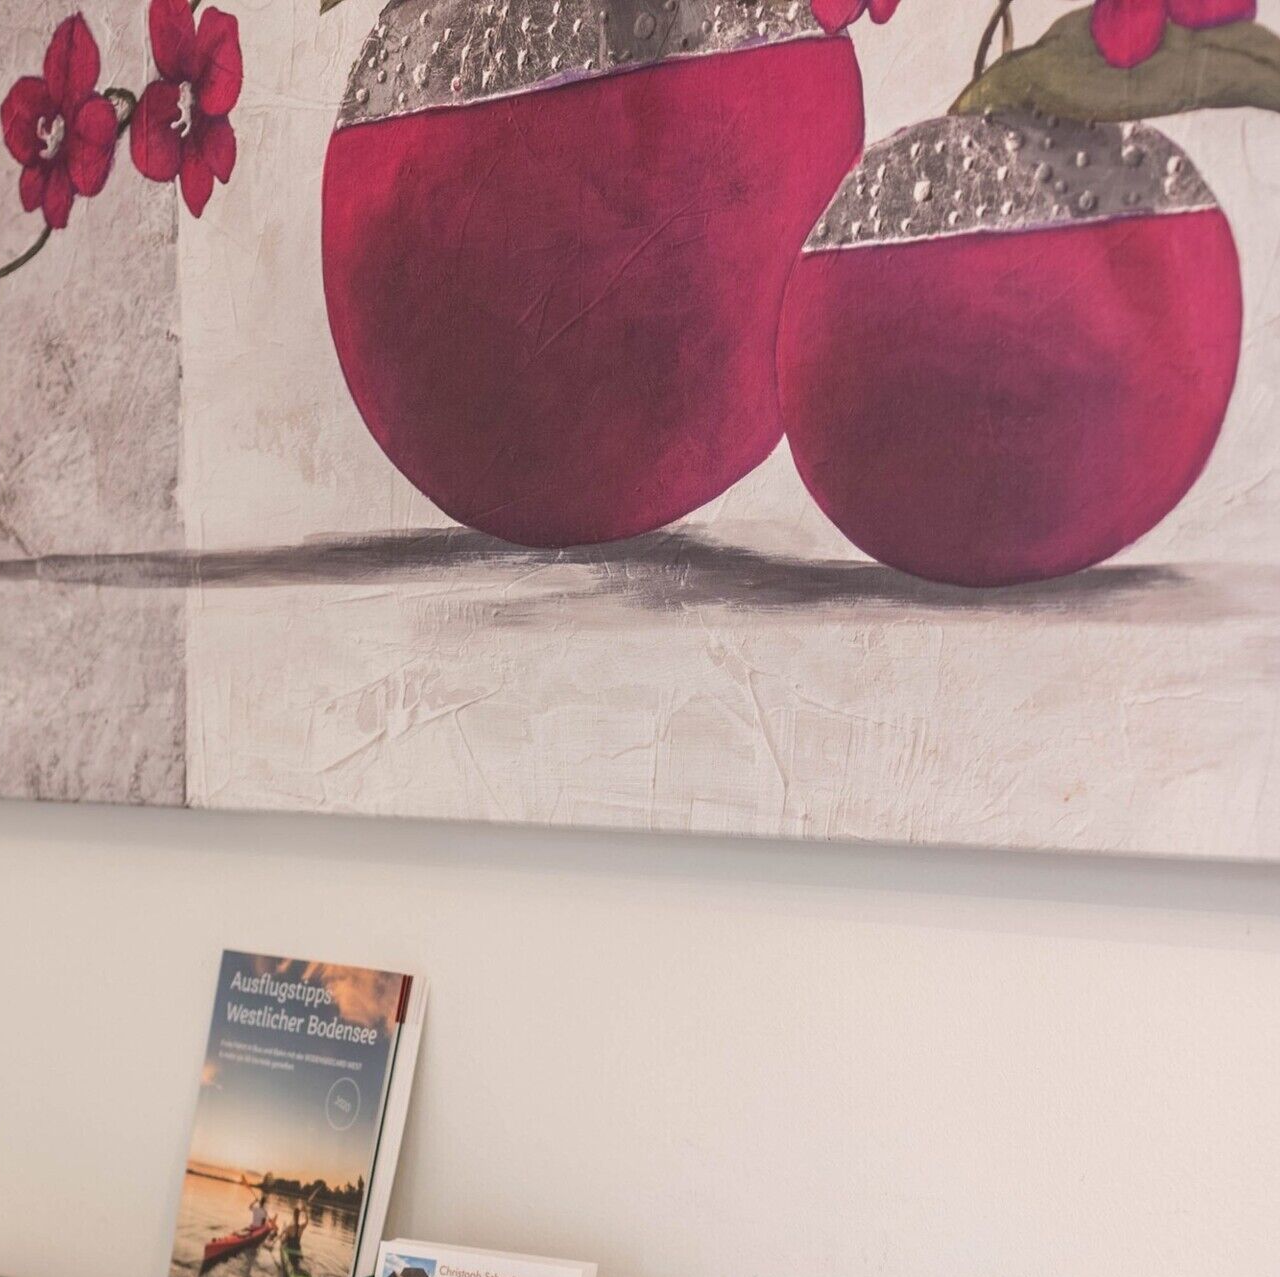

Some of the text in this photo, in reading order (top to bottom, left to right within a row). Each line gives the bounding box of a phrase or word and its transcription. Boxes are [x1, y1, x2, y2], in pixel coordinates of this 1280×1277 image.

[230, 970, 332, 1008] Ausflugstipps
[226, 1001, 378, 1045] Westlicher Bodensee
